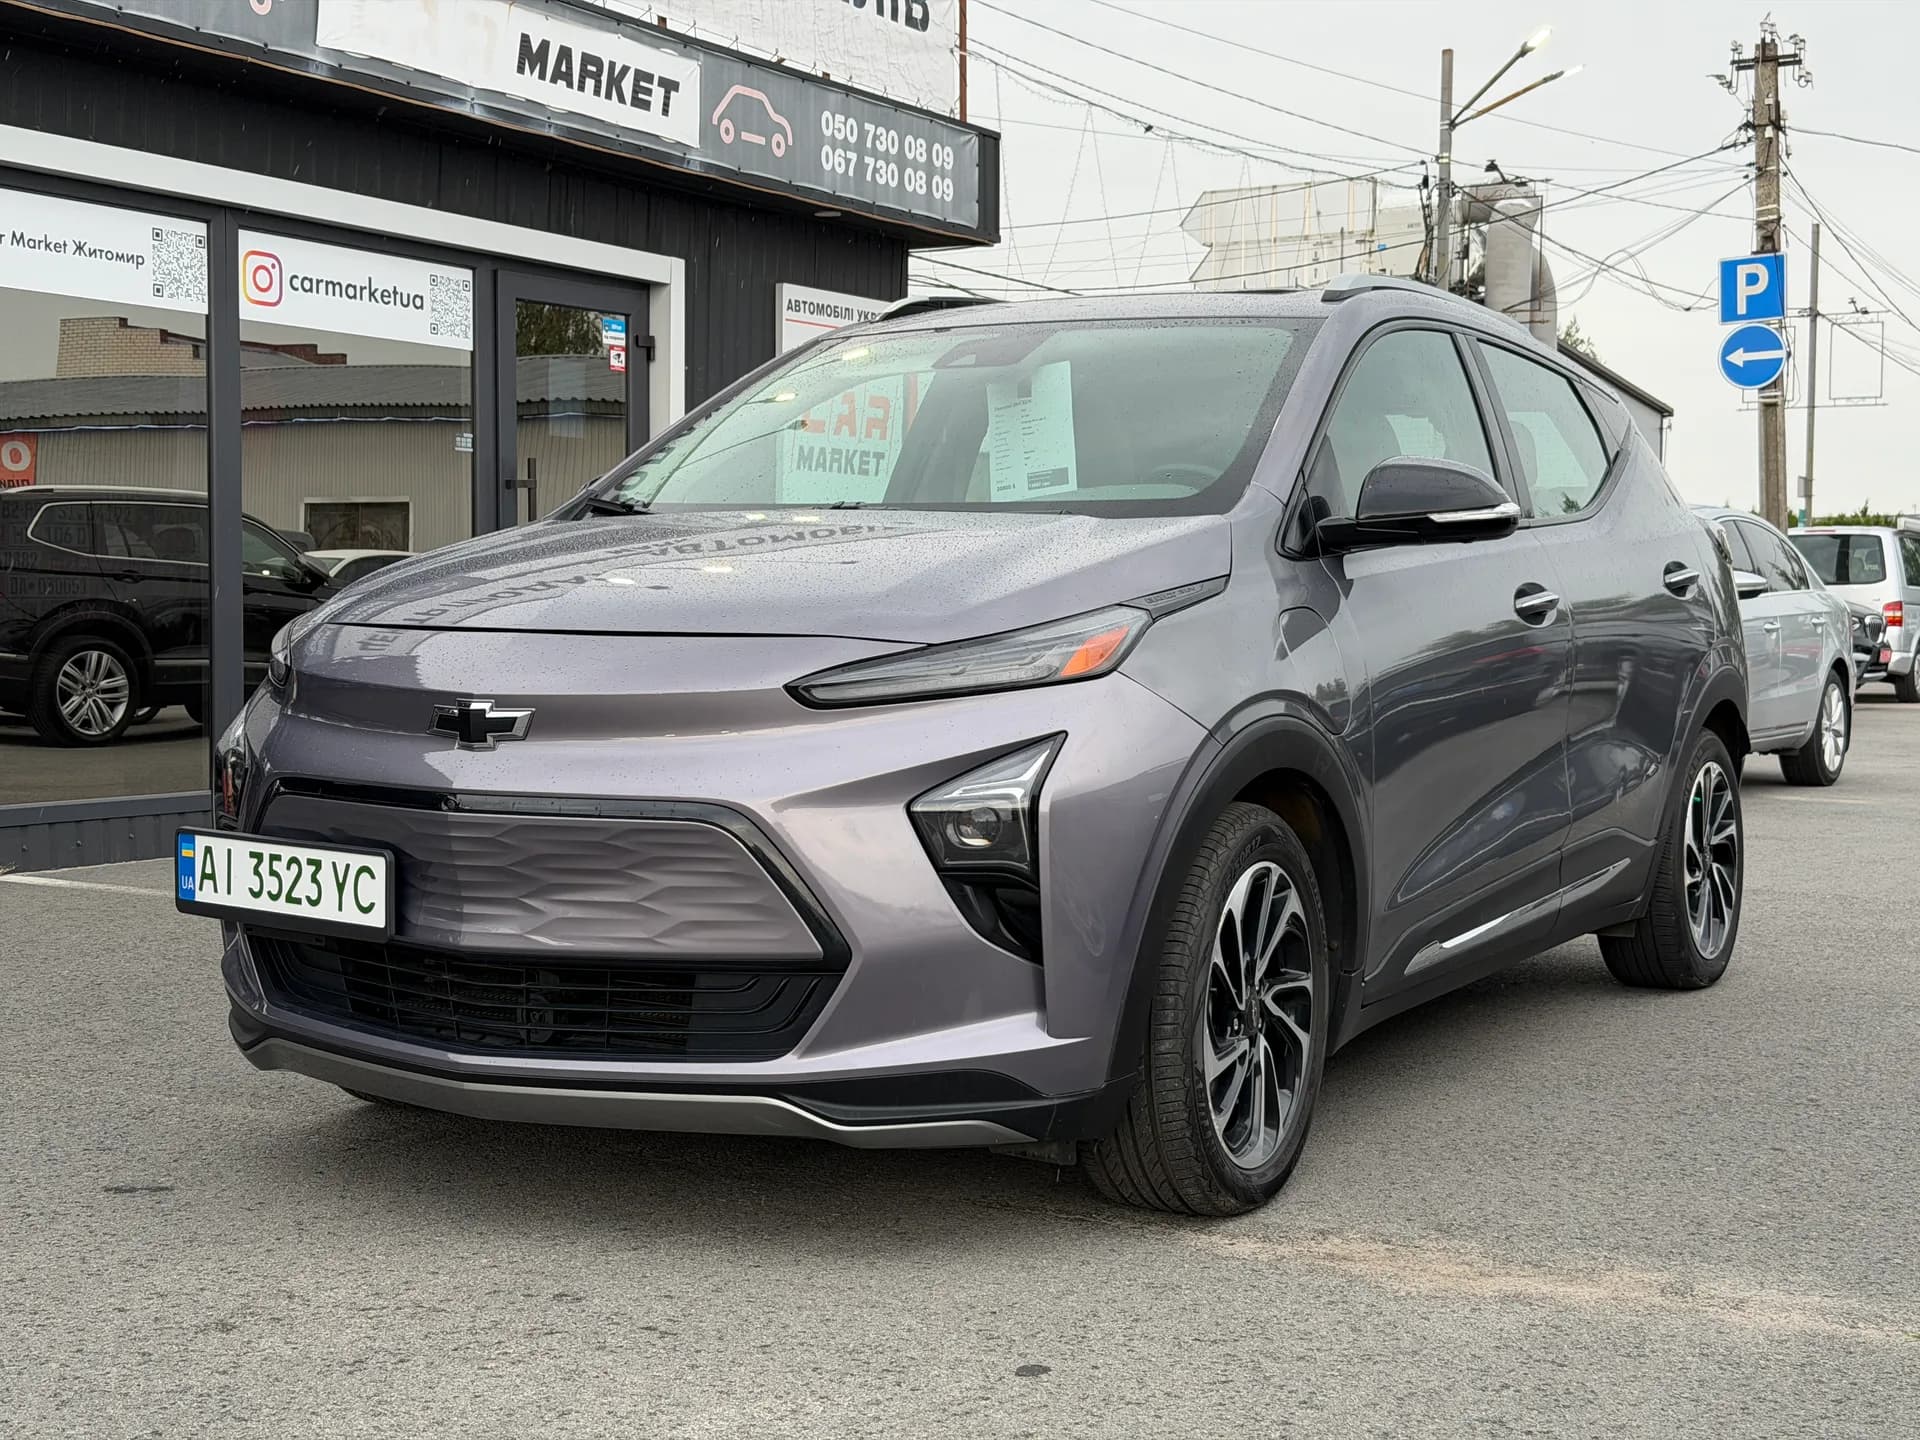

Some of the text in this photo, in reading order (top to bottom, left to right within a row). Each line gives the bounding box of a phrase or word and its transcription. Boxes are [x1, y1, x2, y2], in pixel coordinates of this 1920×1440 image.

[516, 32, 680, 117] MARKET
[821, 110, 954, 170] 050 730 08 09
[821, 144, 954, 202] 067 730 08 09
[10, 230, 145, 270] Market Житомир
[289, 274, 424, 311] carmarketua
[786, 298, 880, 323] АВТОМОБІЛІ УКР
[1737, 263, 1769, 315] P
[796, 445, 885, 477] MARKET
[181, 875, 194, 890] UA
[198, 845, 376, 914] AI 3523 YC
